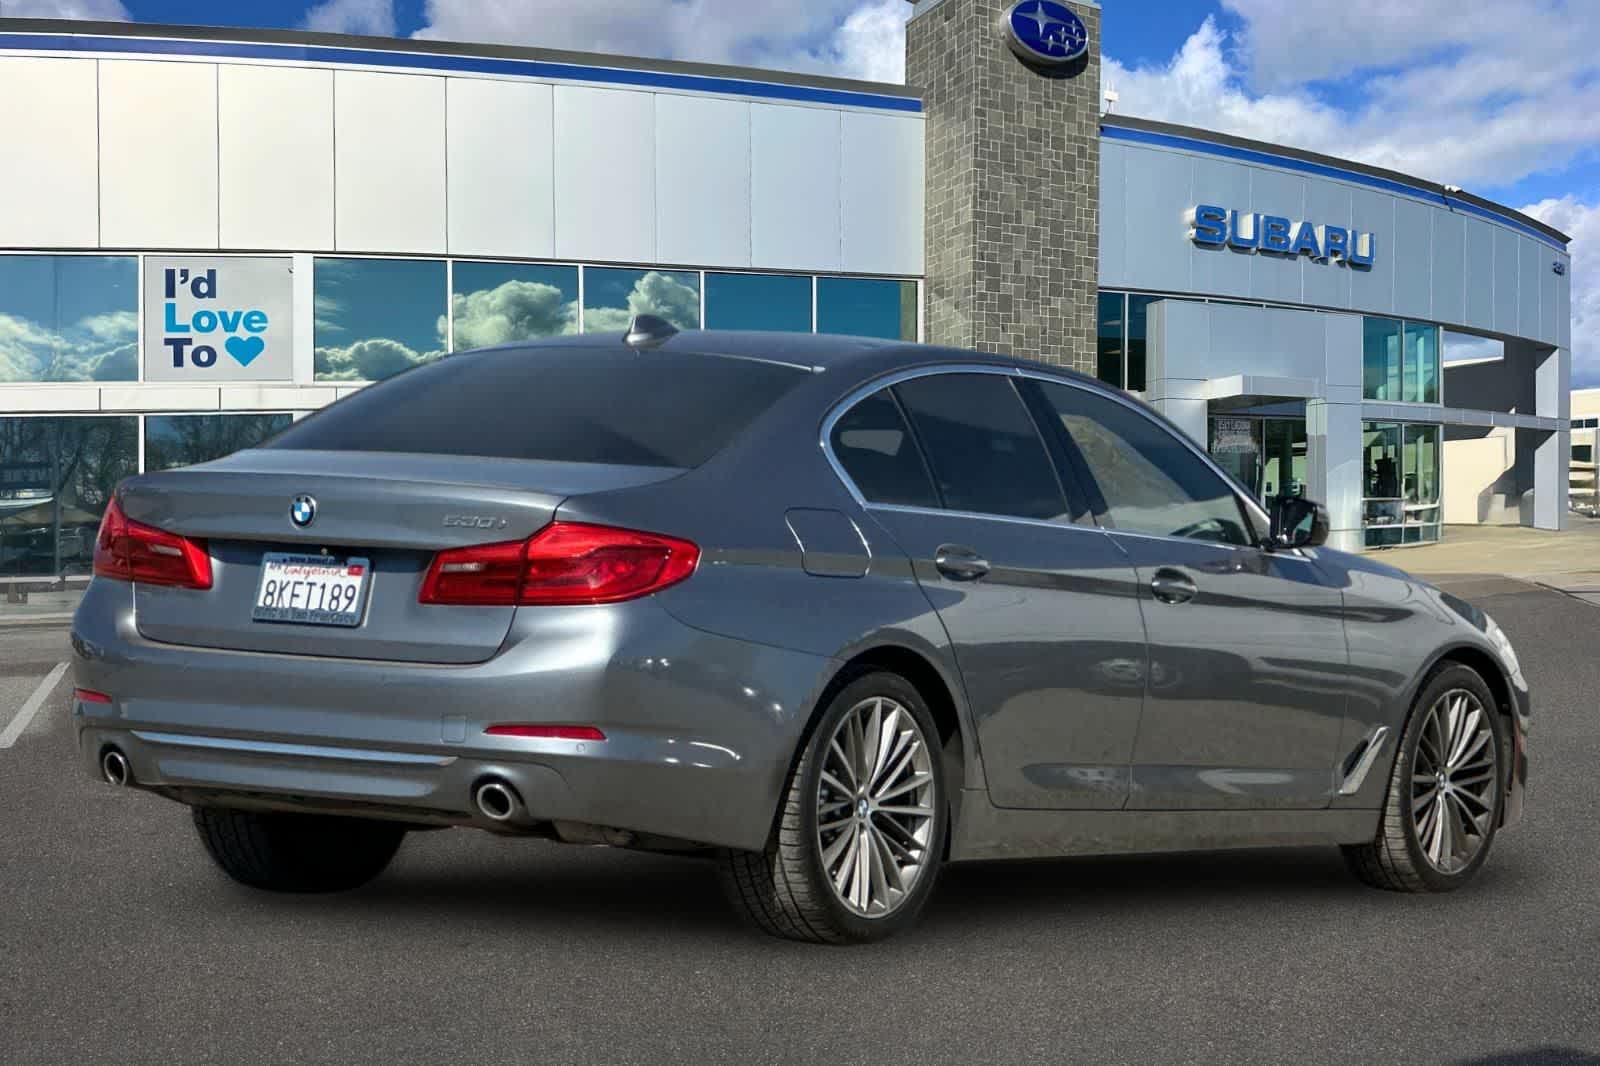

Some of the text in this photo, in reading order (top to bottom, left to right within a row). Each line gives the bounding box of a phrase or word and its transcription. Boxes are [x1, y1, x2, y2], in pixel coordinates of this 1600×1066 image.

[1193, 204, 1376, 267] SUBARU
[164, 302, 269, 333] Love
[163, 337, 217, 368] To
[263, 579, 357, 612] 8KET189
